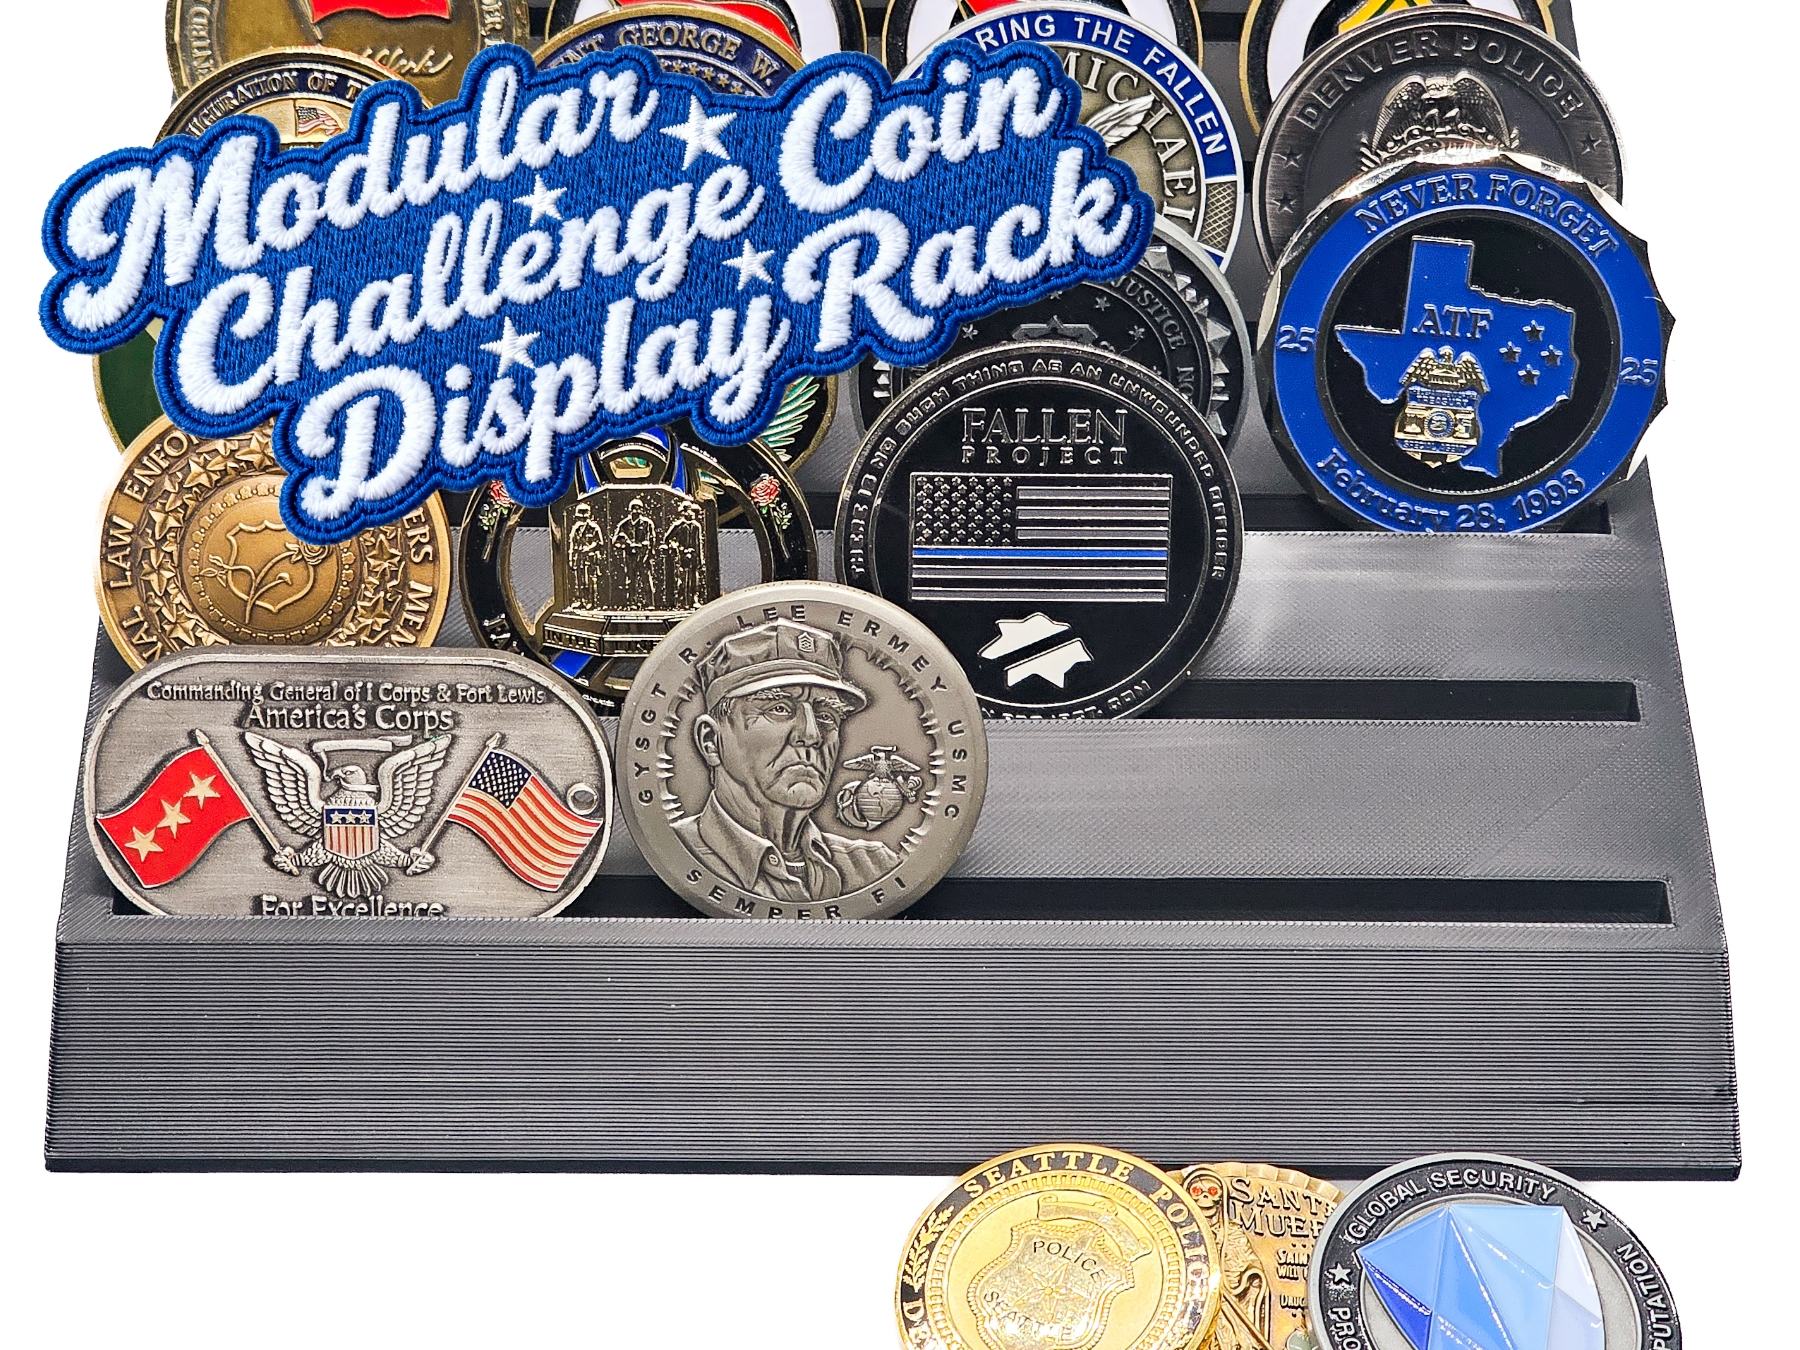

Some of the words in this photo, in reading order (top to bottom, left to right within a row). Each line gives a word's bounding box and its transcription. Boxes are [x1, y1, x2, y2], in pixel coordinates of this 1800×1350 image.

[618, 21, 742, 62] GEORGE
[751, 49, 780, 87] W.
[307, 71, 340, 93] OF
[1074, 17, 1135, 54] THE
[1142, 46, 1228, 156] FALLEN
[1294, 29, 1440, 131] DENVER
[1453, 30, 1584, 121] POLICE
[1354, 173, 1480, 235] NEVER
[1485, 173, 1621, 259] FORGET
[1276, 325, 1317, 354] 25
[1413, 303, 1494, 341] ATF
[951, 358, 1024, 391] THING
[1069, 361, 1103, 381] AN
[1619, 356, 1660, 387] 25
[961, 407, 1129, 446] FALLEN
[961, 446, 1129, 467] PROJECT
[1317, 447, 1450, 533] February
[1511, 468, 1586, 522] 1993
[107, 514, 135, 589] LAW
[147, 680, 265, 706] Commanding
[269, 680, 339, 702] General
[344, 681, 364, 702] of
[378, 682, 431, 708] Corps
[437, 683, 450, 703] &
[455, 683, 494, 704] Fort
[497, 684, 547, 705] Lewis
[633, 682, 666, 805] GYSGT
[736, 604, 806, 630] LEE
[837, 611, 948, 695] ERMEY
[944, 719, 968, 820] USMC
[243, 703, 367, 730] America's
[375, 704, 455, 739] Corps
[262, 894, 304, 917] For
[311, 894, 445, 918] Excellence
[686, 868, 843, 920] SEMPER
[870, 876, 907, 906] FI
[961, 1150, 1136, 1200] SEATTLE
[1347, 1178, 1428, 1241] GLOBAL
[1429, 1168, 1557, 1202] SECURITY
[1033, 1240, 1108, 1284] POLICE
[983, 1290, 1074, 1342] SEATTE
